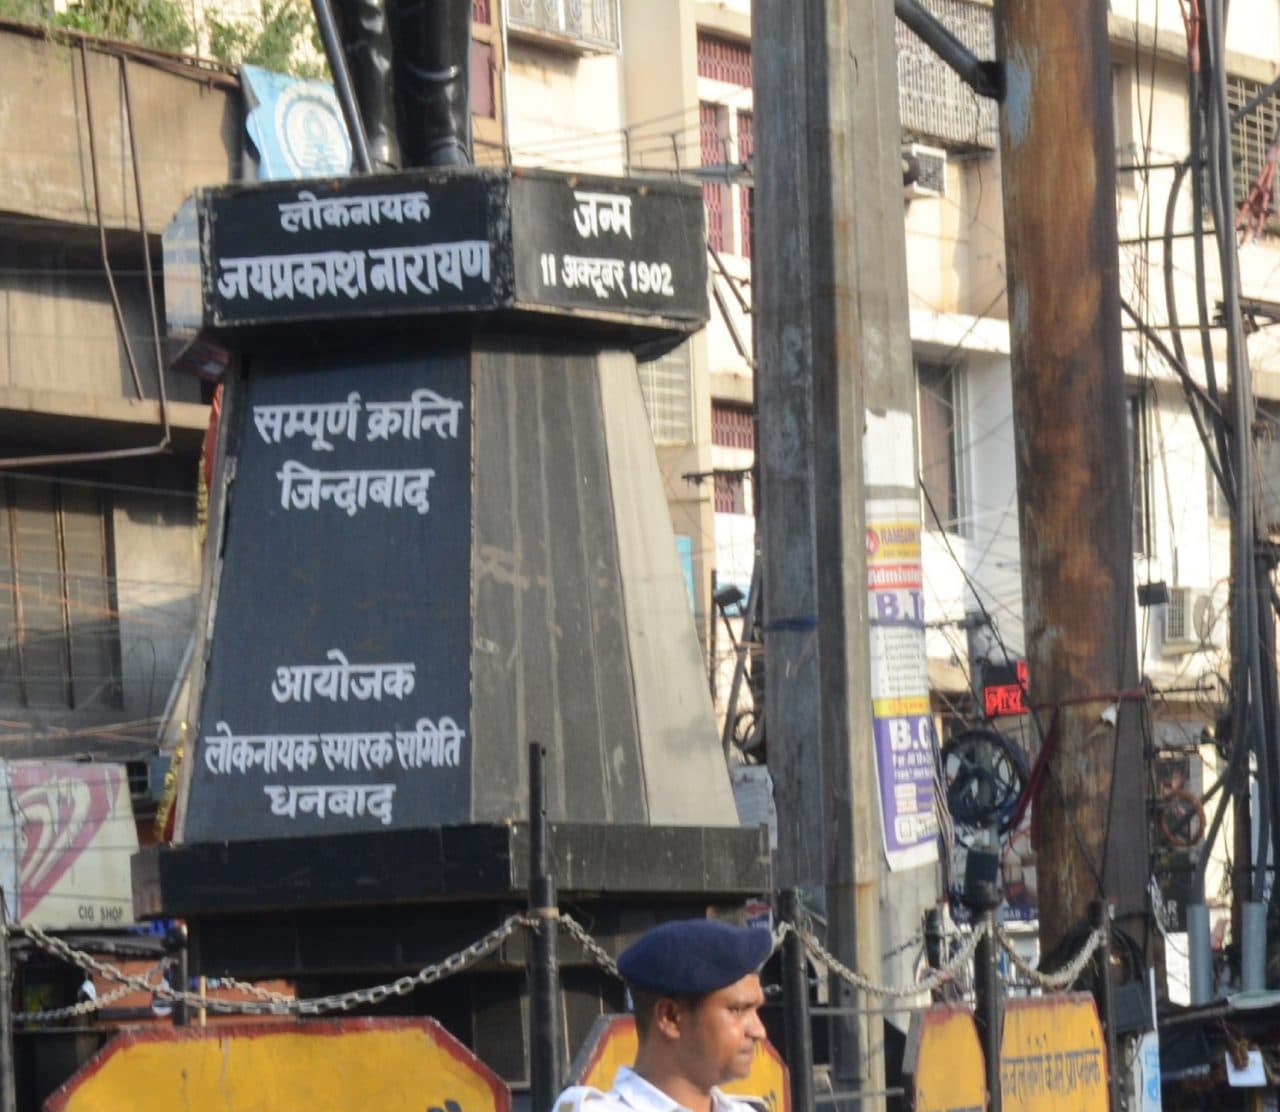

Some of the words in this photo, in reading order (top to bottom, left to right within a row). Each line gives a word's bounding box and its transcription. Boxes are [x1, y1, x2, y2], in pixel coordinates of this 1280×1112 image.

[279, 191, 430, 232] लोकनायक
[574, 191, 632, 240] जन्म
[218, 252, 370, 300] जयप्रकाश
[369, 240, 490, 295] नारायण
[541, 253, 556, 286] 11
[562, 255, 628, 299] अक्टूबर
[629, 261, 674, 296] 1902
[253, 391, 360, 451] सम्पूर्ण
[366, 388, 463, 440] क्रान्ति
[277, 461, 434, 515] जिन्दाबाद
[272, 648, 415, 702] आयोजक
[205, 722, 319, 774] लोकनायक
[320, 731, 393, 771] स्मारक
[395, 717, 465, 769] समिति
[264, 783, 396, 824] धनबाद
